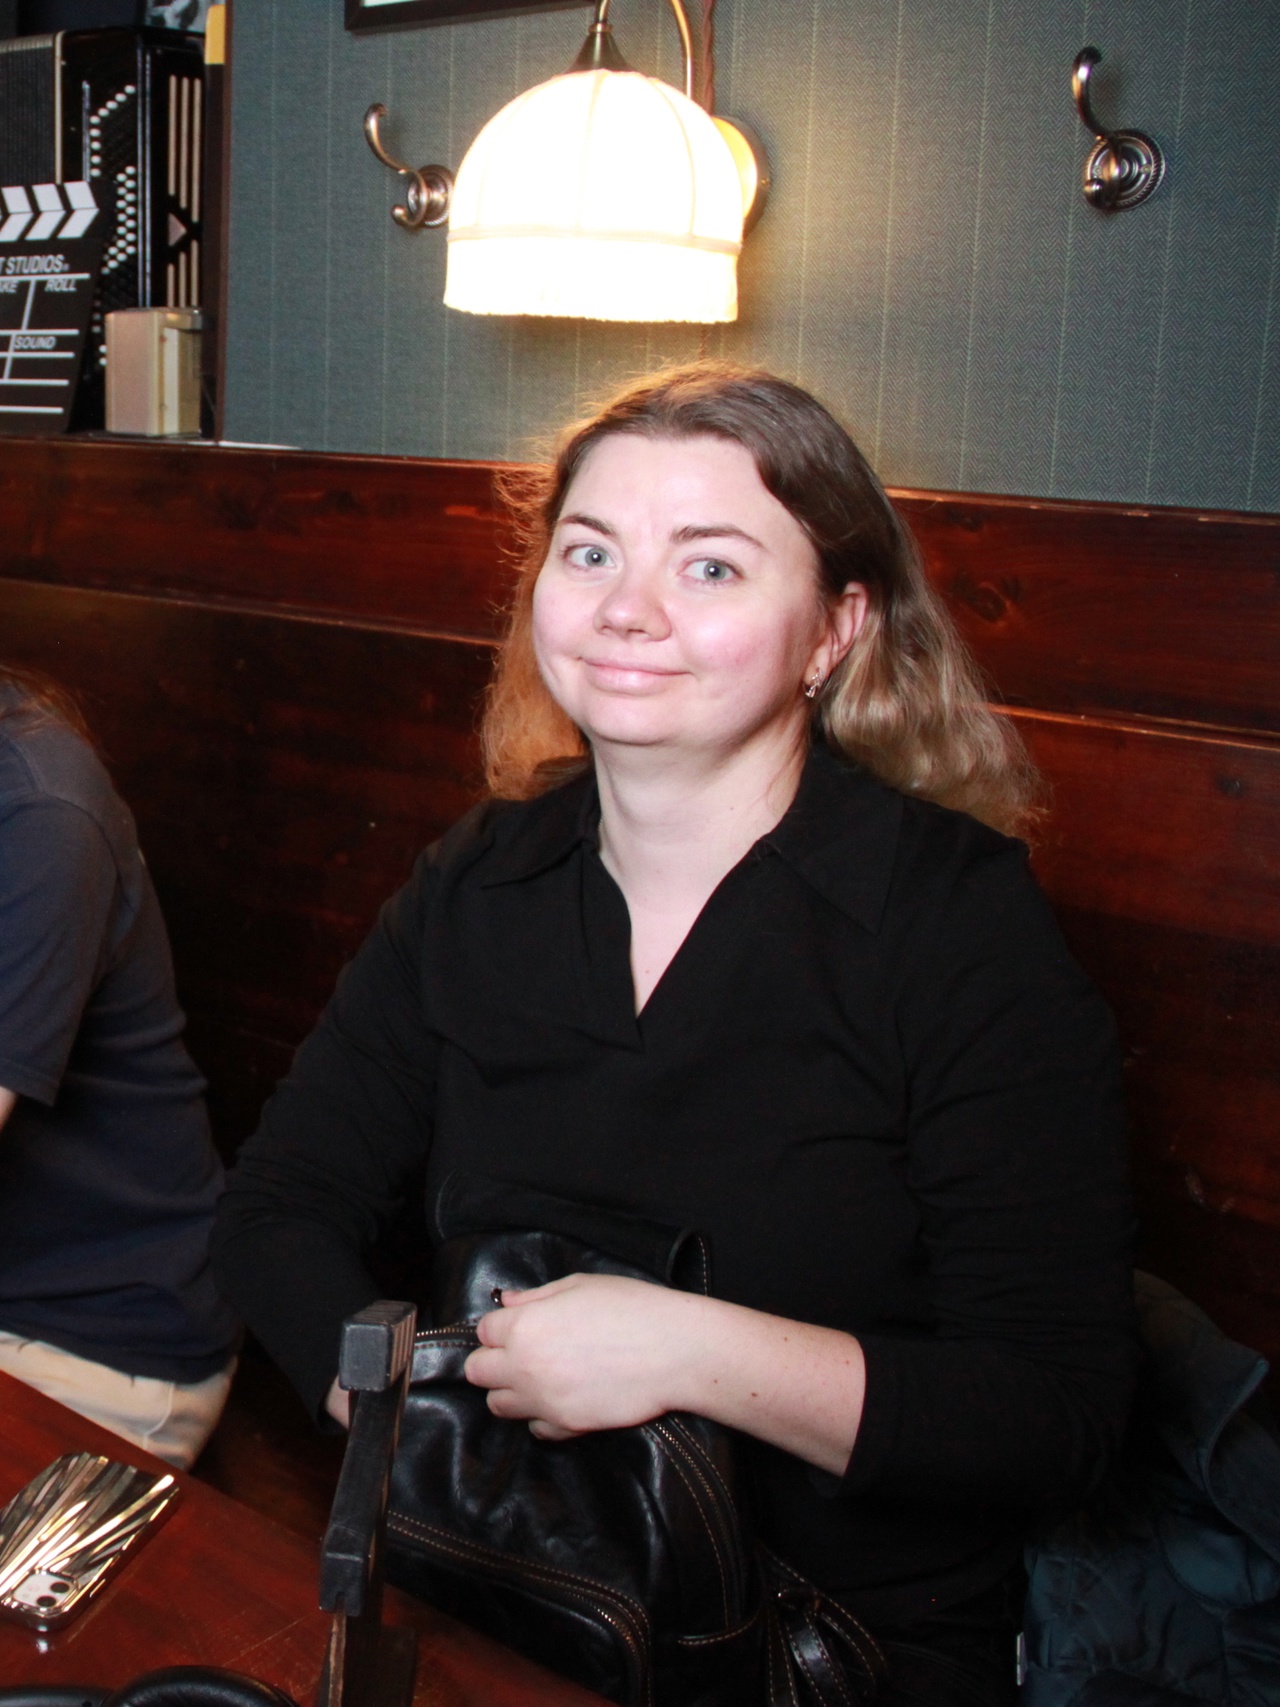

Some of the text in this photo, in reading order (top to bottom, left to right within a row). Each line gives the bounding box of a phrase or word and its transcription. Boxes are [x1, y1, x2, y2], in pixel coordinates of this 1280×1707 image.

[5, 254, 65, 275] STUDIOS
[44, 278, 77, 292] ROLL
[13, 336, 56, 350] SOUND
